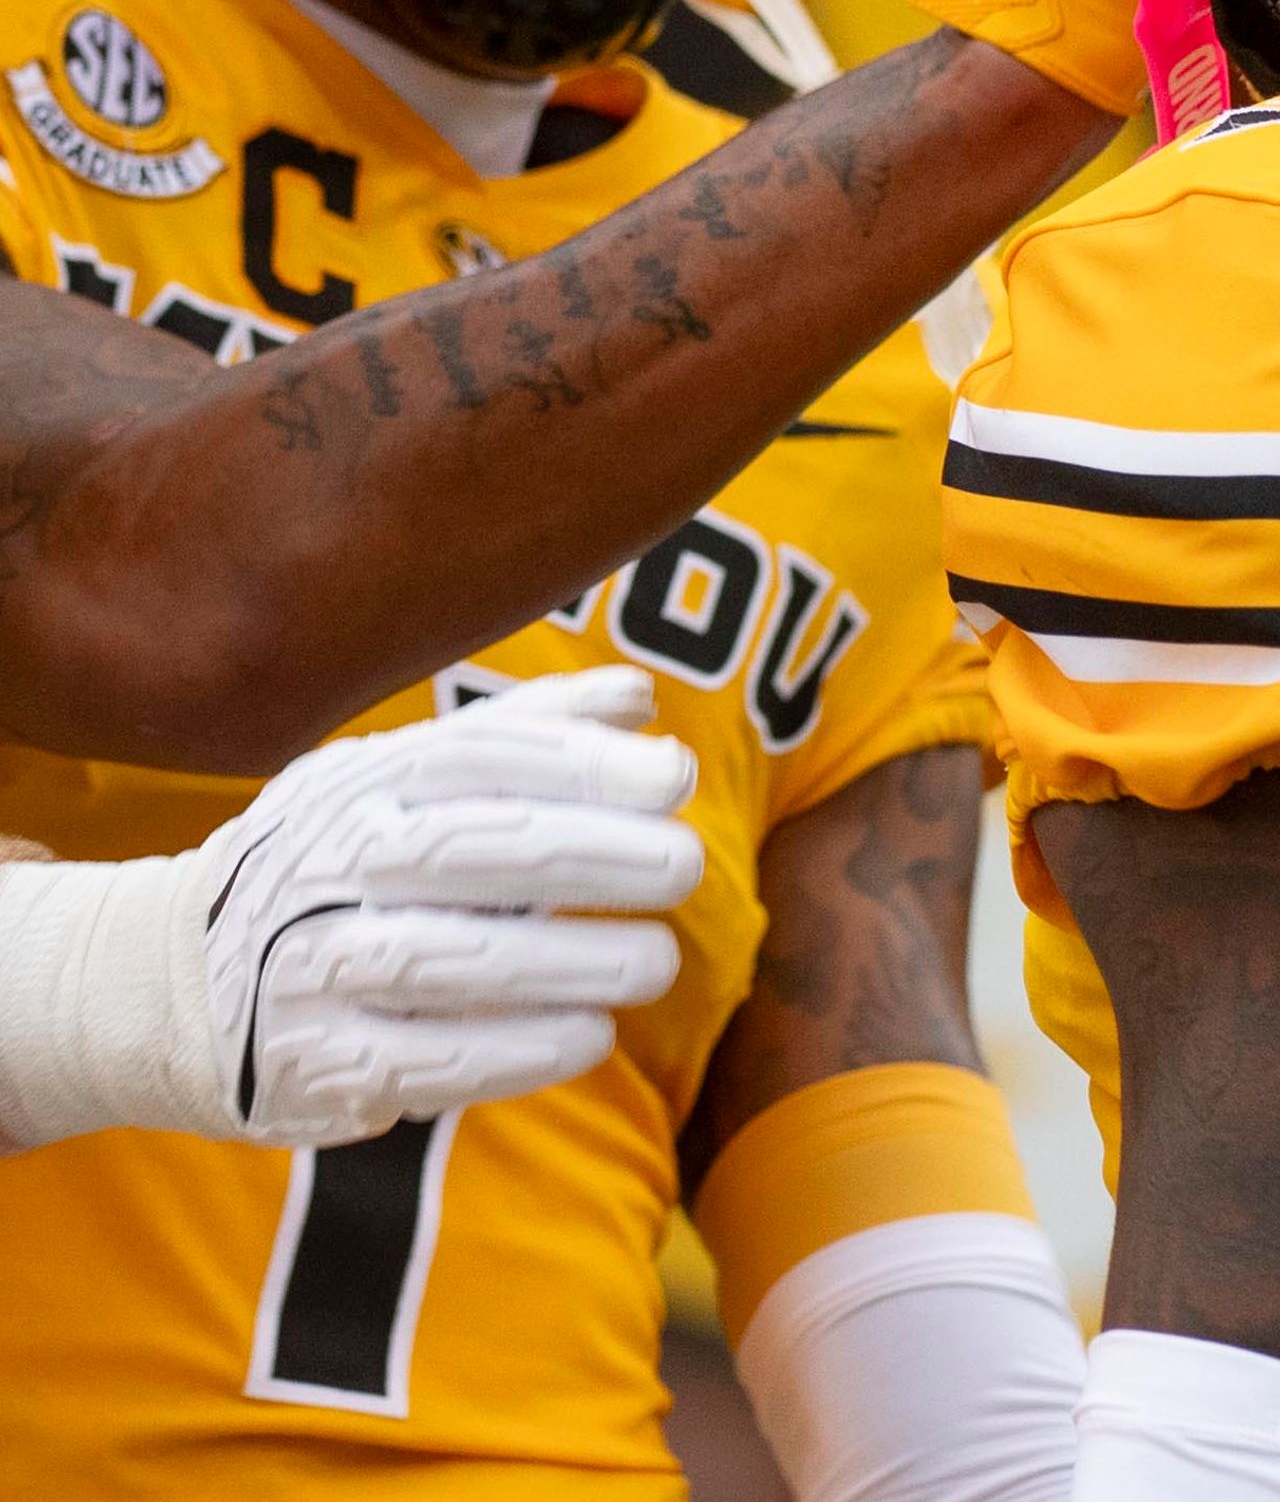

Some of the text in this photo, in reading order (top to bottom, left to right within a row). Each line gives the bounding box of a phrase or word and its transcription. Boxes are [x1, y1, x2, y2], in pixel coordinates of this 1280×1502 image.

[65, 9, 169, 131] SEC
[28, 99, 196, 194] GRADUATE
[242, 127, 361, 326] C
